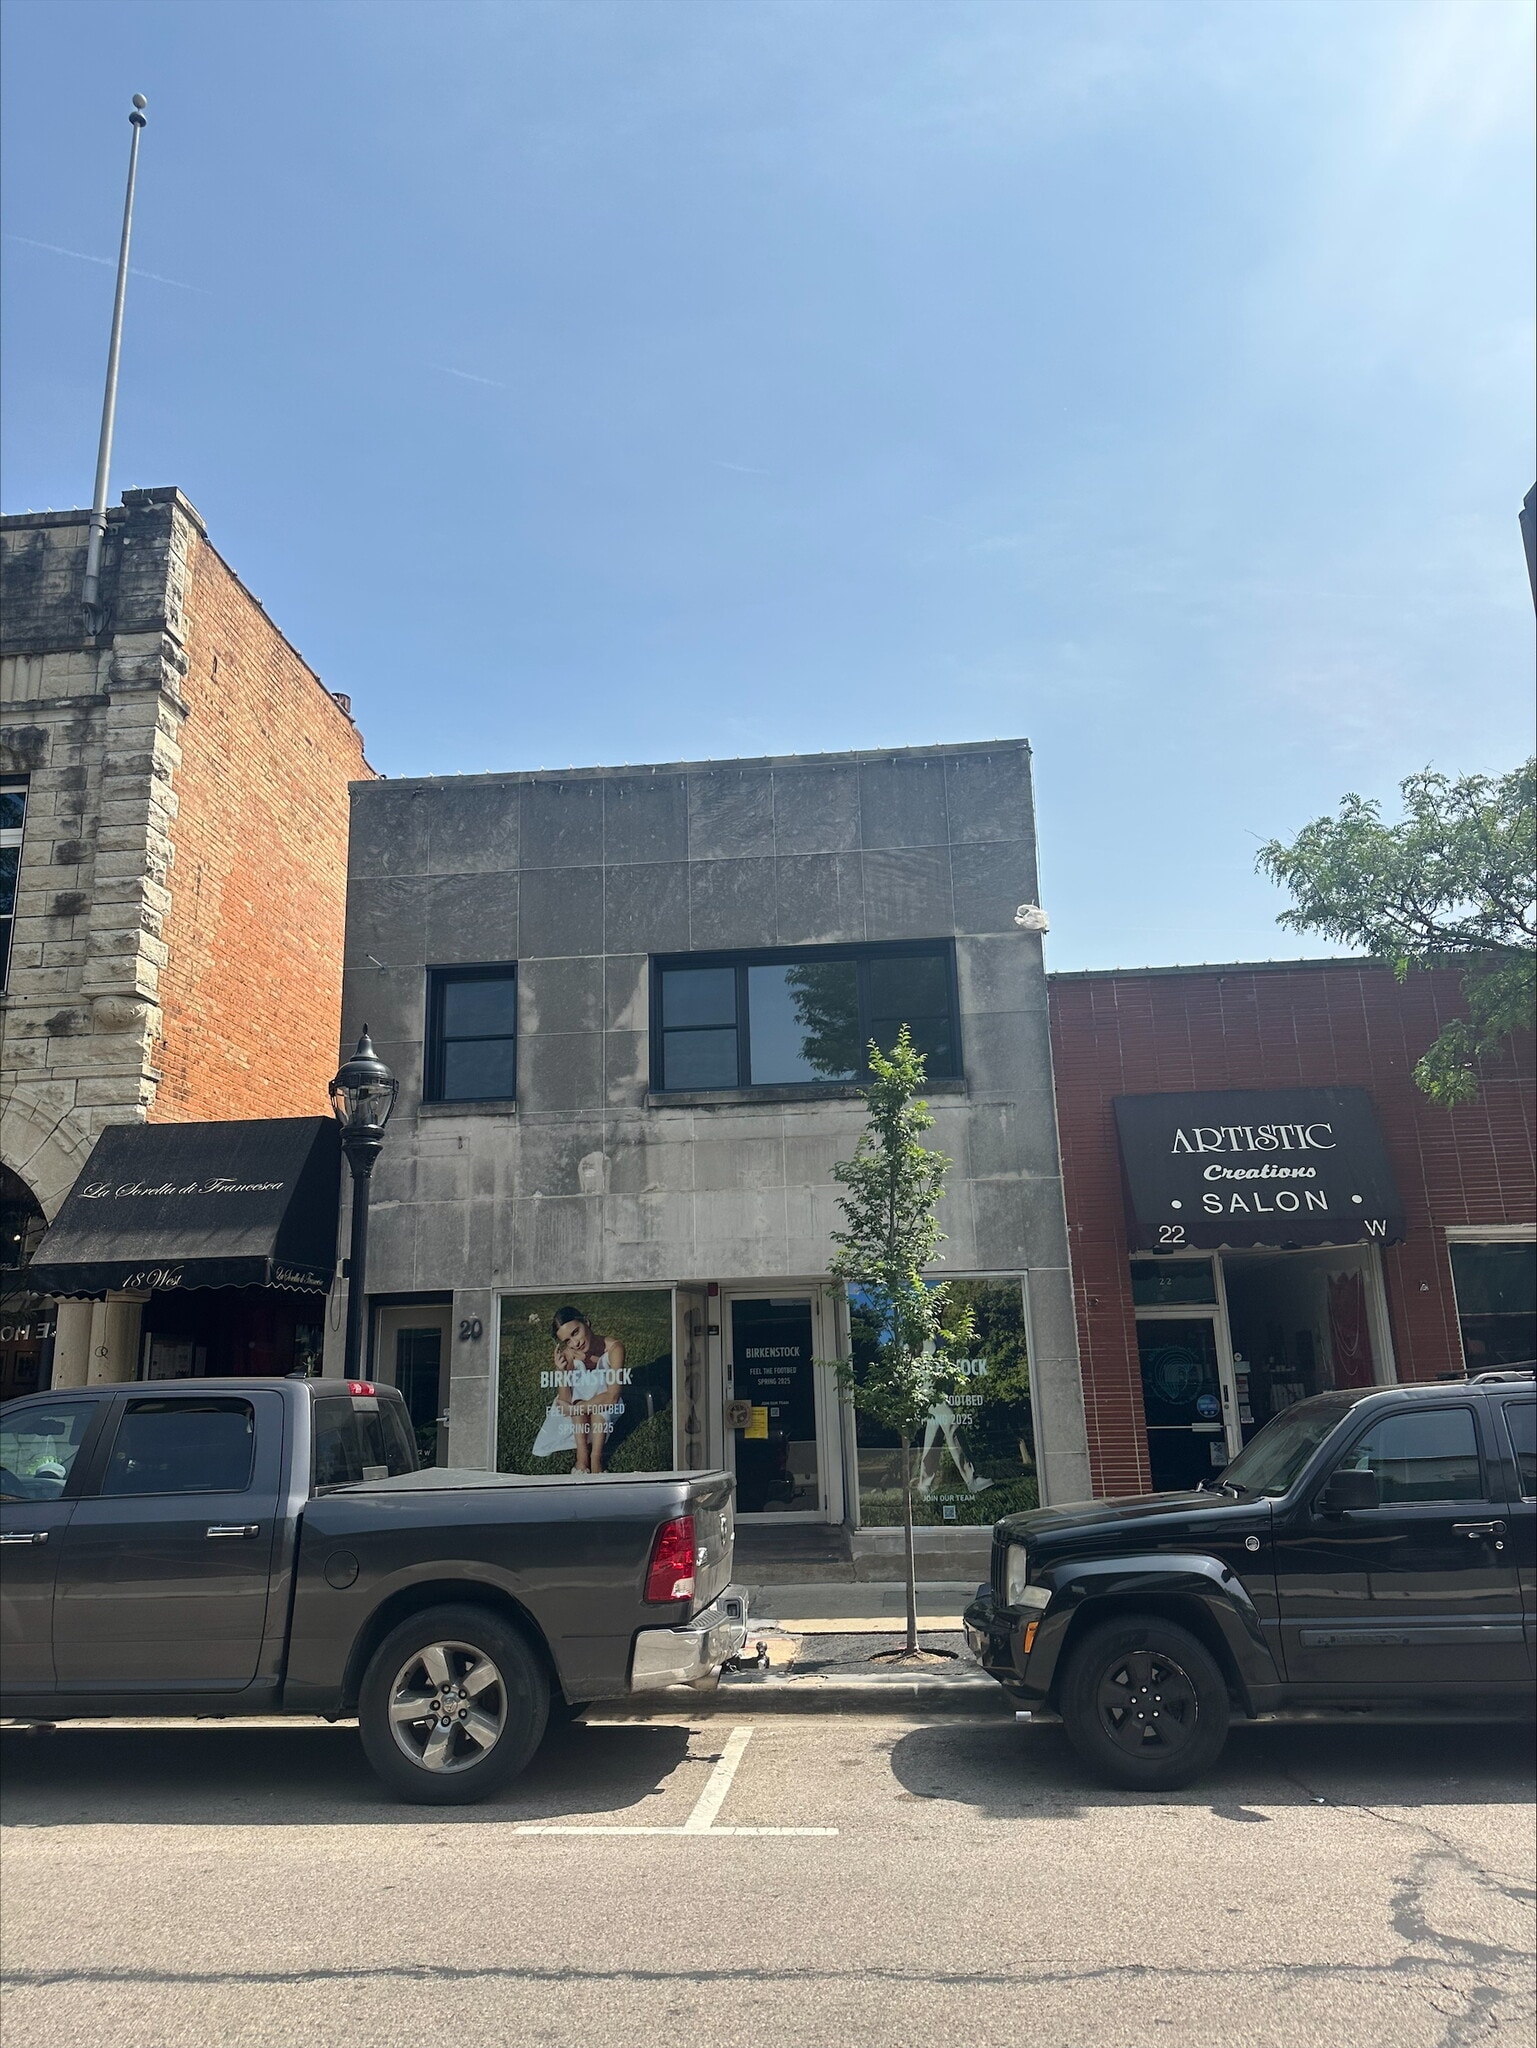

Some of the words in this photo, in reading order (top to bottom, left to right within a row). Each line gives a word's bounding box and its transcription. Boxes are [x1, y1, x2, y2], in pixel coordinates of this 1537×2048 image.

[1171, 1123, 1336, 1154] ARTISTIC
[1203, 1164, 1317, 1181] Creations
[77, 1182, 110, 1199] La
[114, 1181, 177, 1199] Sorella
[178, 1182, 197, 1195] di
[198, 1177, 284, 1194] Francesca
[1202, 1190, 1329, 1214] SALON
[1158, 1225, 1186, 1243] 22
[1364, 1219, 1387, 1236] W
[122, 1272, 145, 1287] 18
[147, 1266, 185, 1287] West
[1160, 1277, 1172, 1285] 22
[459, 1318, 483, 1341] 20
[745, 1346, 801, 1358] BIRKENSTOCK
[749, 1367, 762, 1375] FEEL
[763, 1367, 773, 1375] THE
[774, 1366, 797, 1375] FOOTBED
[540, 1368, 632, 1388] BIRKENSTOCK
[777, 1377, 791, 1385] 2025
[948, 1395, 983, 1406] OOTBED
[546, 1405, 565, 1416] FEEL
[569, 1404, 585, 1415] THE
[587, 1403, 625, 1415] FOOTBED
[951, 1413, 973, 1425] 2025
[558, 1423, 590, 1434] SPRING
[592, 1422, 614, 1433] 2025
[940, 1494, 955, 1502] OUR
[956, 1494, 976, 1502] TEAM
